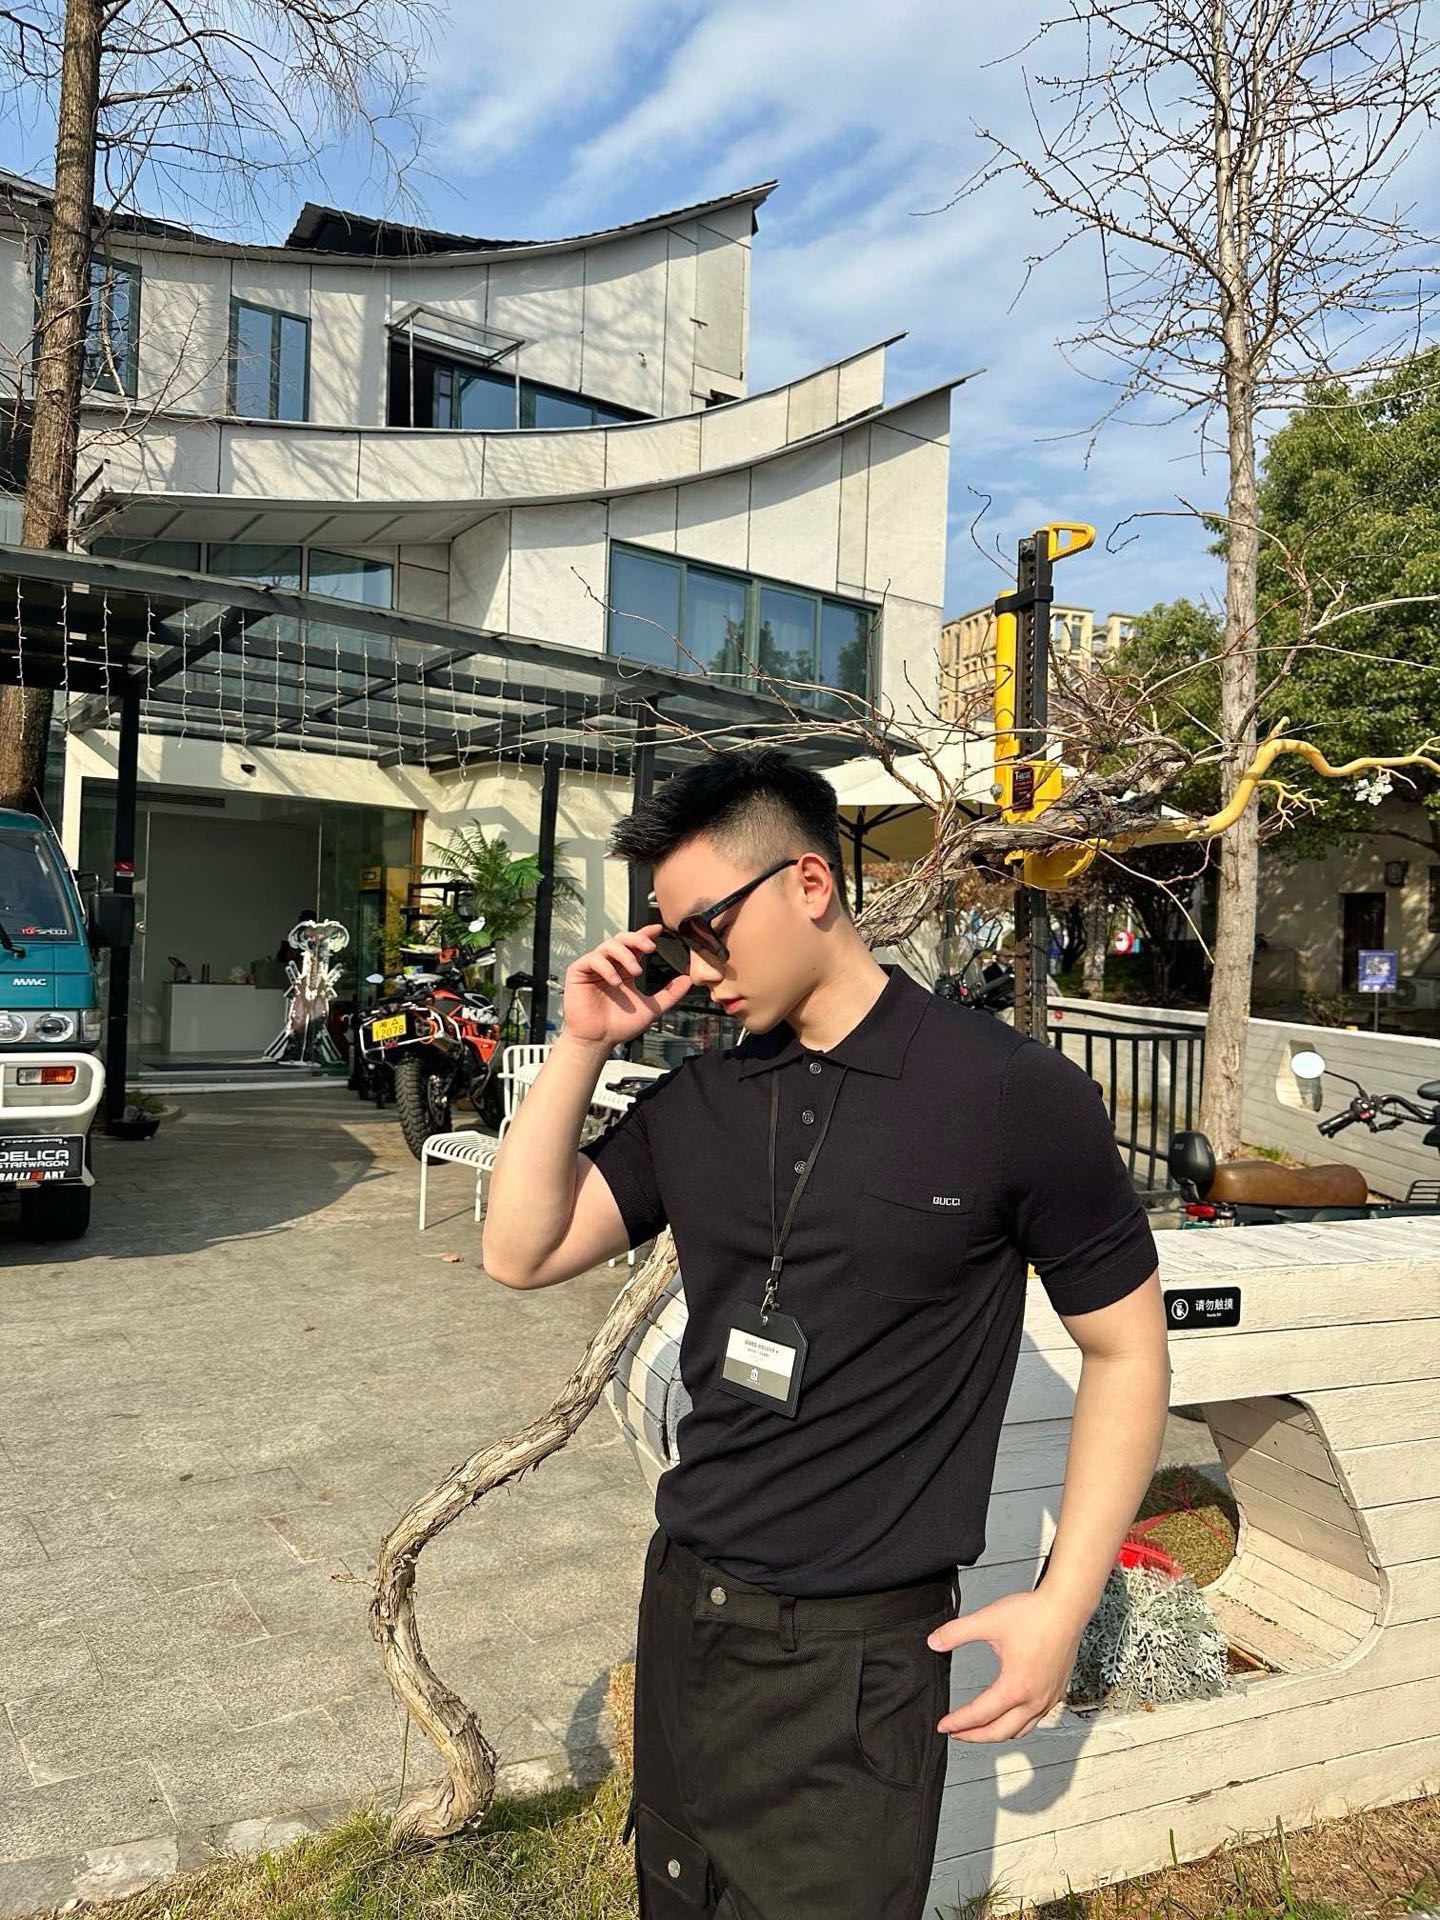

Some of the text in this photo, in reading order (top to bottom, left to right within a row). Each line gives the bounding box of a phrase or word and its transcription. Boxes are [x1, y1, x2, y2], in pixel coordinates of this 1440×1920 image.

[13, 978, 47, 986] MMC
[44, 1170, 66, 1180] ART
[932, 1196, 961, 1206] GUCCI
[1195, 1298, 1234, 1311] 请勿触摸
